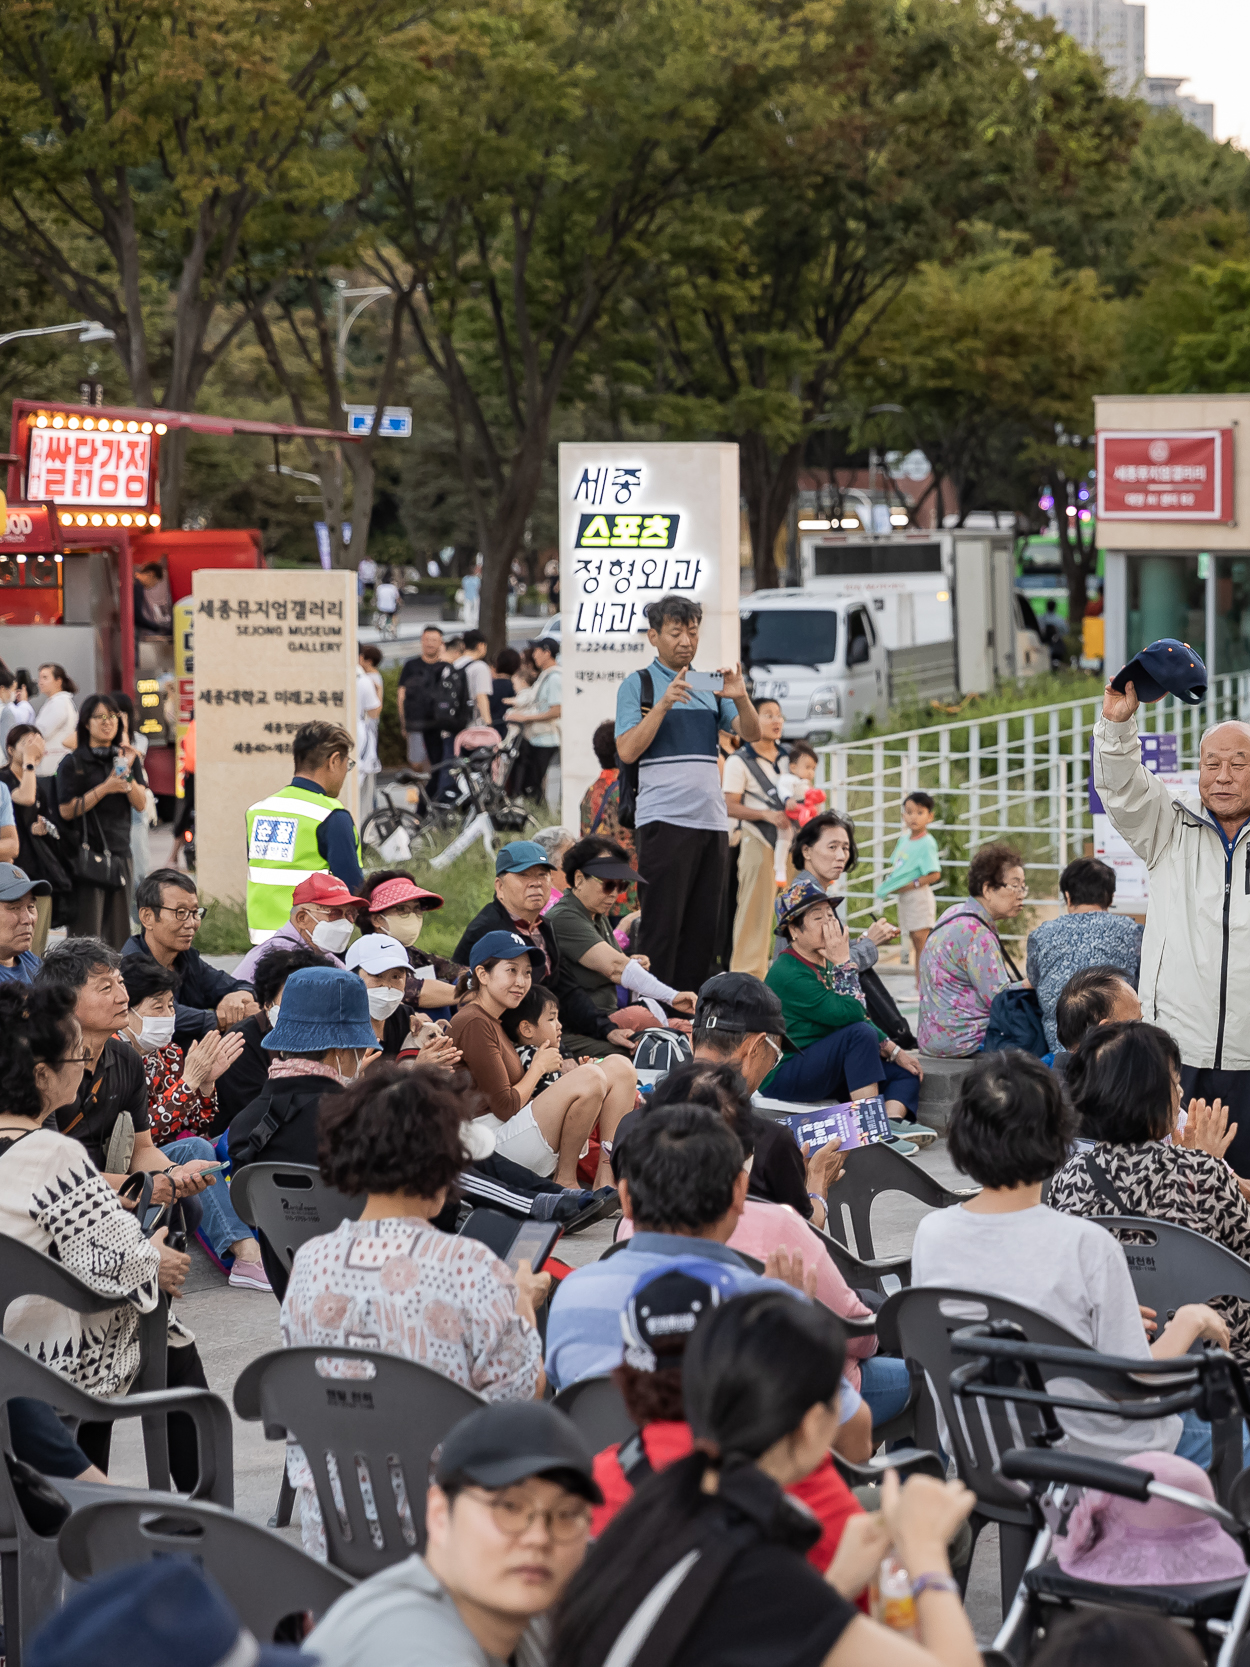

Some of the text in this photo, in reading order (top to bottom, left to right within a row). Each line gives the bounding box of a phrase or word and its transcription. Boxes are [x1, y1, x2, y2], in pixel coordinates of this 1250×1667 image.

[573, 468, 642, 505] 세종
[580, 514, 672, 548] 스포츠
[573, 558, 703, 594] 정형외과
[199, 599, 344, 621] 세종뮤지엄갤러리
[574, 602, 650, 633] 내과
[236, 625, 343, 637] SEJONG MUSEUM
[287, 641, 343, 653] GALLERY
[199, 689, 270, 707] 세종대학교
[1126, 1255, 1156, 1267] 탈천하
